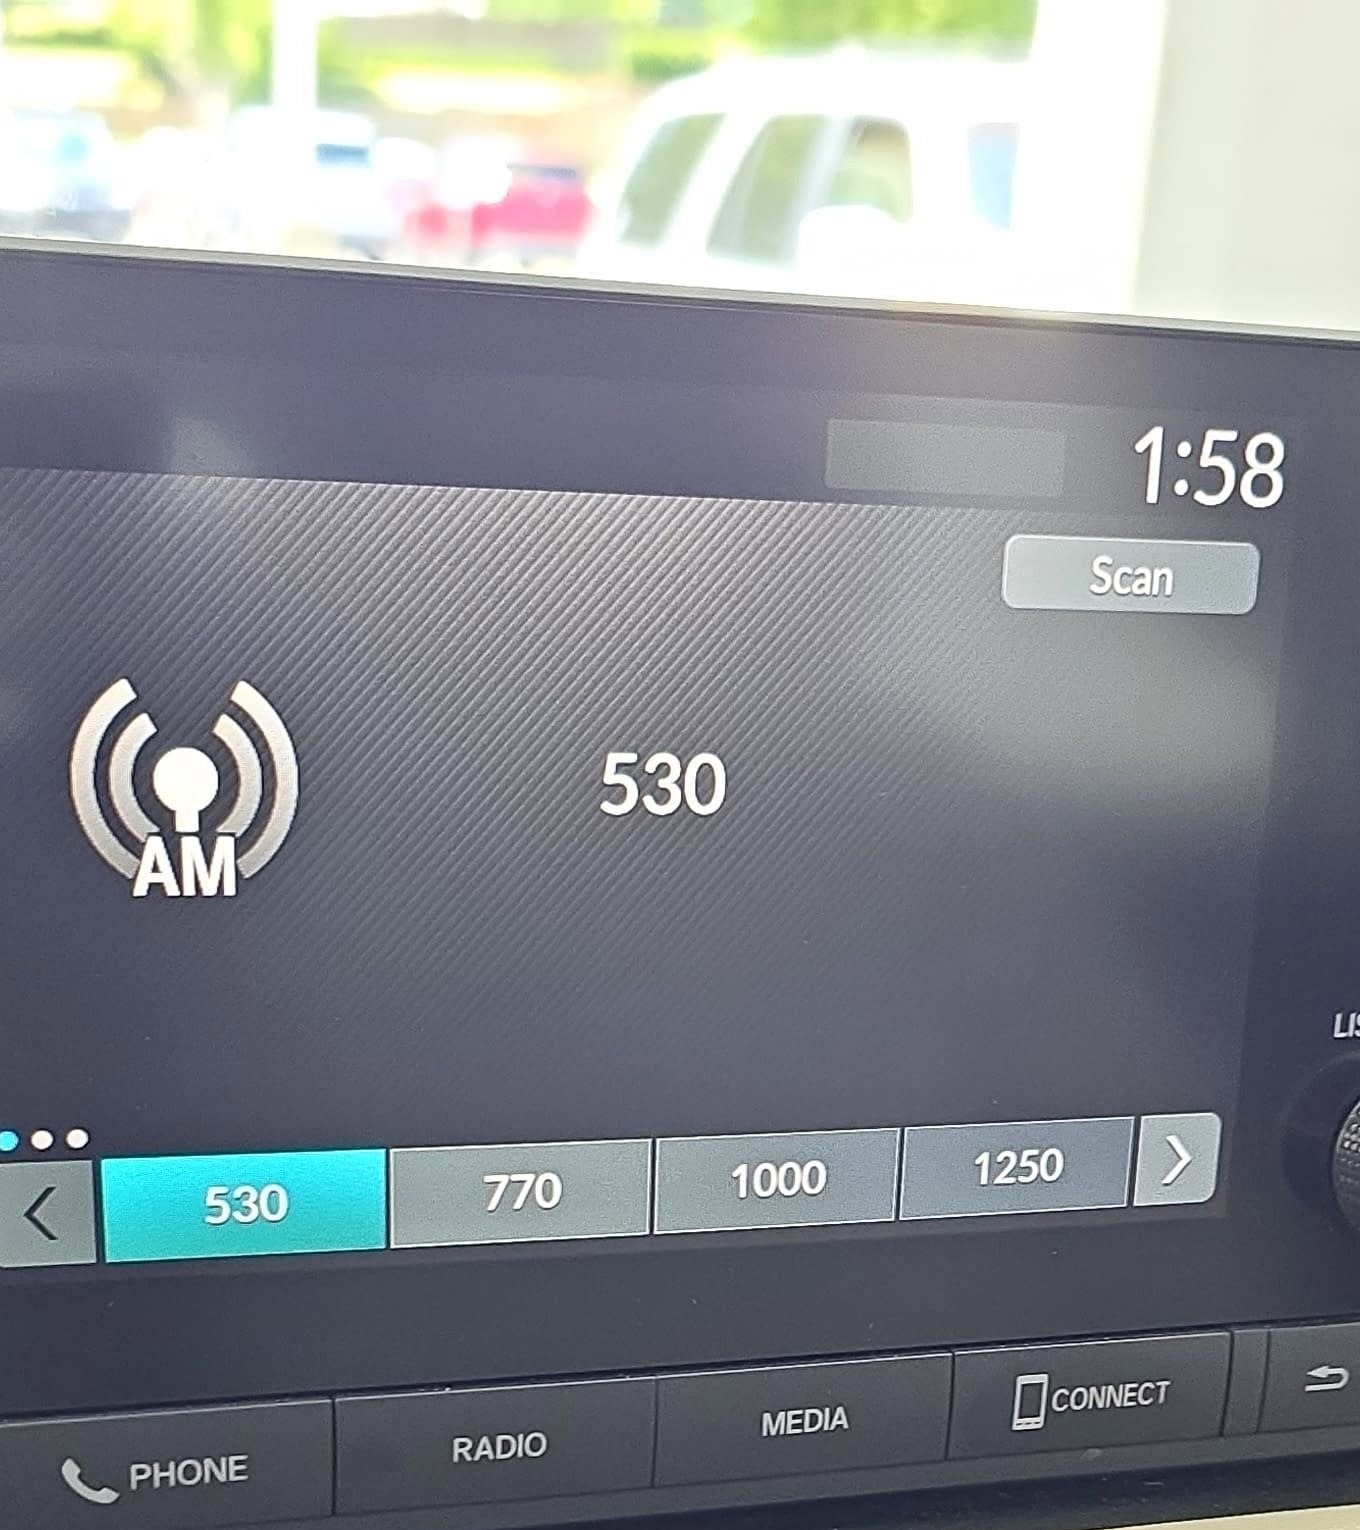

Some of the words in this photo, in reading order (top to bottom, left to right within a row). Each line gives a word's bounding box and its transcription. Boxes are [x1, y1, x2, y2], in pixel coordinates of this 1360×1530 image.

[1135, 426, 1285, 508] 1:58
[1089, 556, 1173, 597] Scan
[599, 752, 727, 816] 530
[132, 836, 237, 897] AM
[732, 1160, 827, 1198] 1000
[974, 1148, 1064, 1185] 1250
[204, 1185, 289, 1226] 530
[483, 1172, 563, 1212] 770
[1052, 1381, 1171, 1413] CONNECT
[761, 1406, 849, 1437] MEDIA
[452, 1432, 548, 1463] RADIO
[130, 1455, 249, 1490] PHONE
